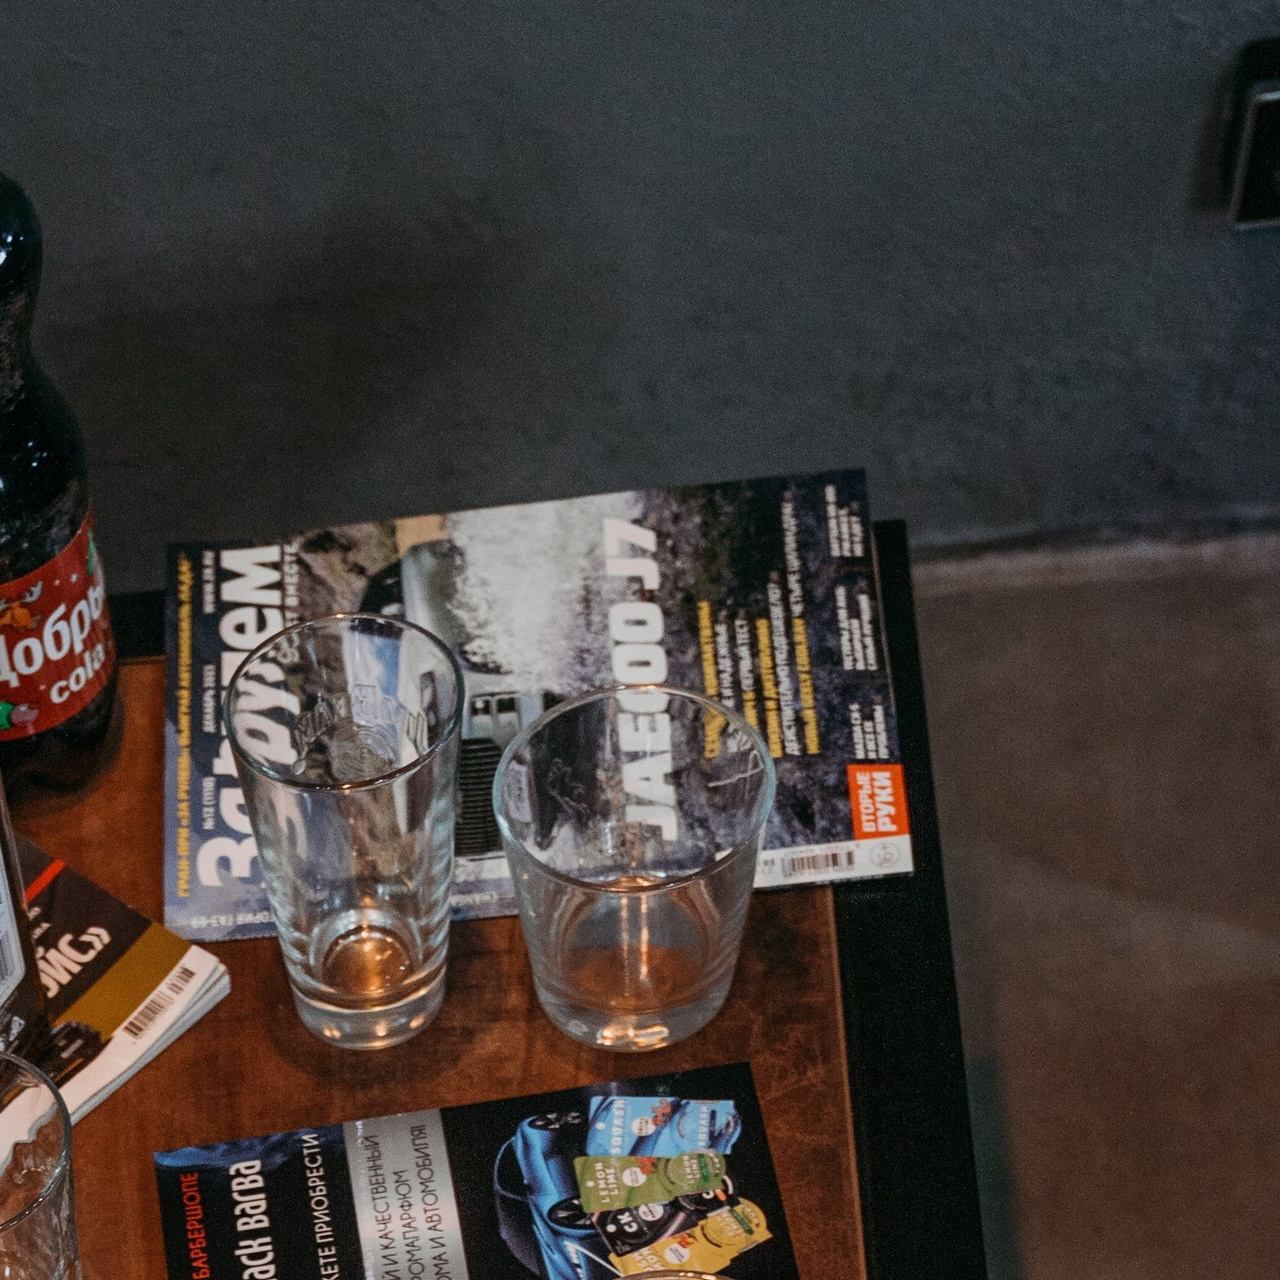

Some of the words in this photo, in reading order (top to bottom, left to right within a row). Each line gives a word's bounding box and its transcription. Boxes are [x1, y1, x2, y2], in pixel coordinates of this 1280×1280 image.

[603, 518, 660, 590] J7
[733, 617, 749, 646] ТЕСТ
[50, 643, 104, 704] cola
[609, 600, 678, 842] JAECOO
[855, 771, 877, 833] ВТОРЫЕ
[872, 769, 898, 833] РУКИ
[197, 790, 261, 888] За
[604, 1097, 631, 1155] SQUASH
[301, 1133, 336, 1242] ПРИОБРЕСТИ
[365, 1134, 398, 1254] КАЧЕСТВЕННЫЙ
[410, 1124, 443, 1234] АВТОМОБИЛЯ!
[594, 1161, 609, 1203] LEMON
[605, 1166, 618, 1195] LIME
[180, 1172, 211, 1280] БАРБЕРШОПЕ
[617, 1210, 639, 1233] CK
